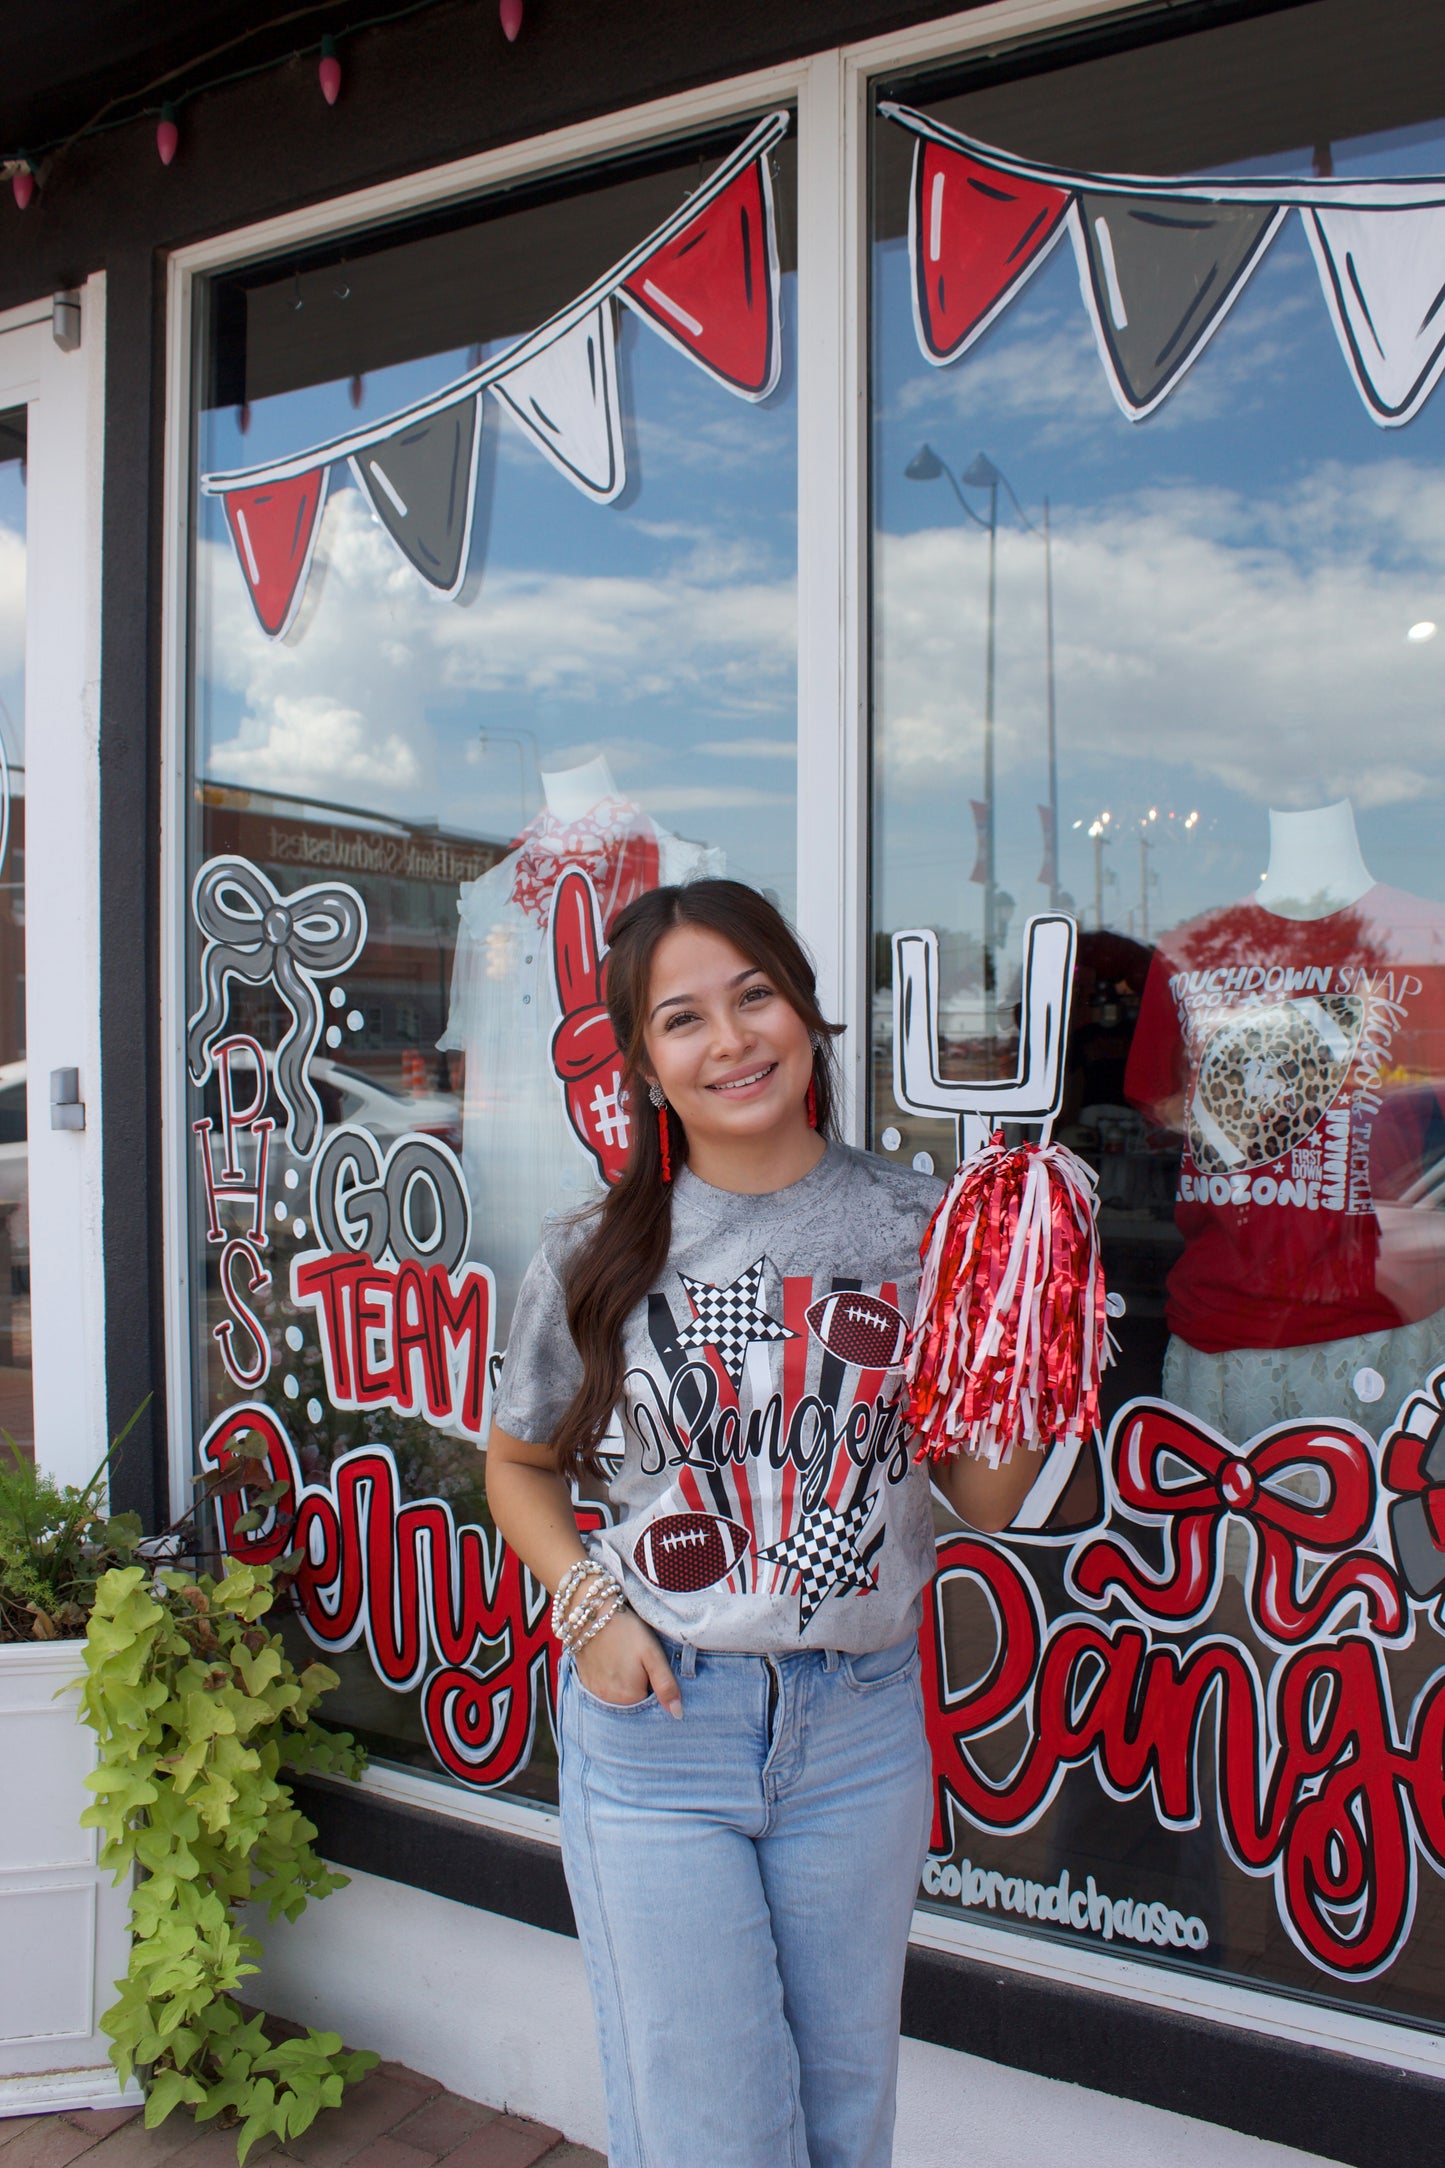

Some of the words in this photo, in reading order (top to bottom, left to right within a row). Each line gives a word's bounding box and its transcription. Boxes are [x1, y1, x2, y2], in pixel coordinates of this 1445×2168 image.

[1169, 966, 1332, 1004] TOUCHDOWN
[1335, 966, 1422, 1004] SNAP
[310, 1124, 472, 1278] GO
[1180, 1175, 1322, 1210] ENDZONE
[1291, 1148, 1322, 1165] FIRST
[1291, 1163, 1322, 1181] DOWN
[1321, 1109, 1350, 1211] GRIDIRON
[1350, 1122, 1378, 1214] TACKLE
[193, 1034, 275, 1390] PHS
[290, 1249, 496, 1450] TEAM
[623, 1361, 918, 1516] Rangers
